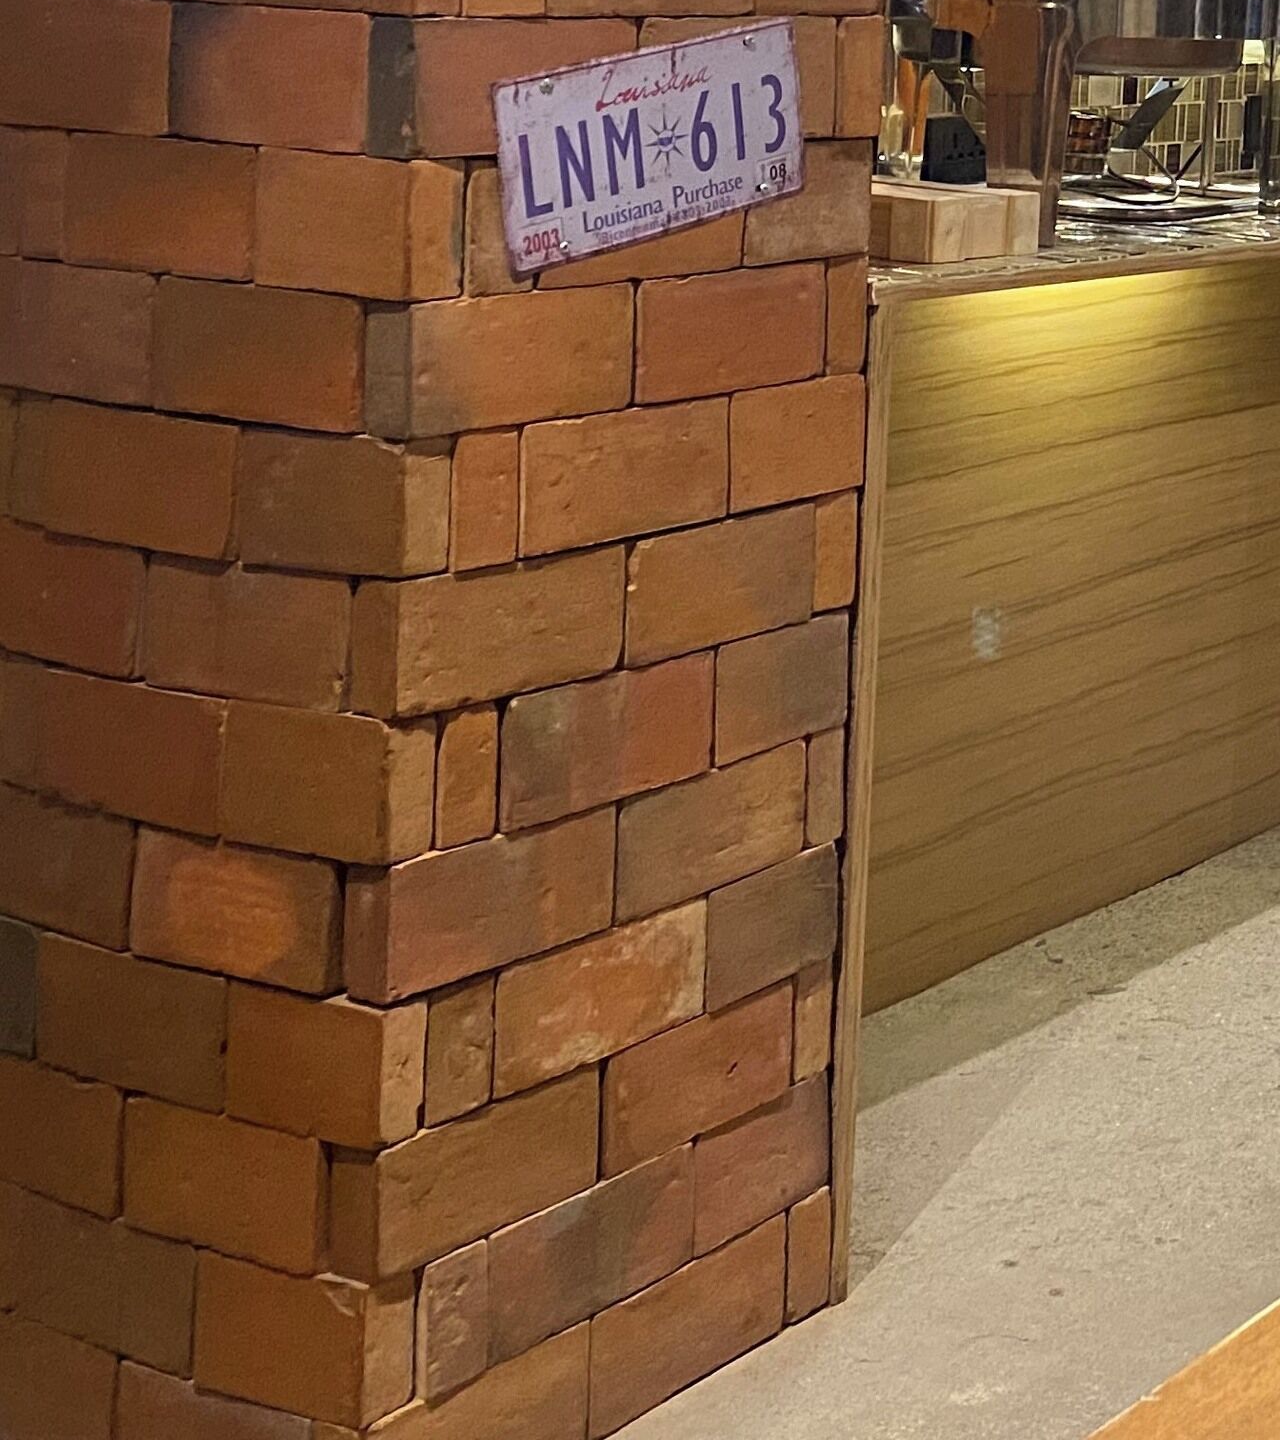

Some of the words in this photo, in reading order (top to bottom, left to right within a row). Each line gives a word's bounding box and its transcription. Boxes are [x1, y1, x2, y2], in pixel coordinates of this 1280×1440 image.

[595, 62, 713, 112] Louisiana
[518, 106, 646, 219] LNM
[690, 73, 787, 173] 613
[768, 162, 787, 181] 08
[582, 199, 664, 234] Louisiana
[672, 175, 744, 209] Purchase
[522, 229, 561, 256] 2003
